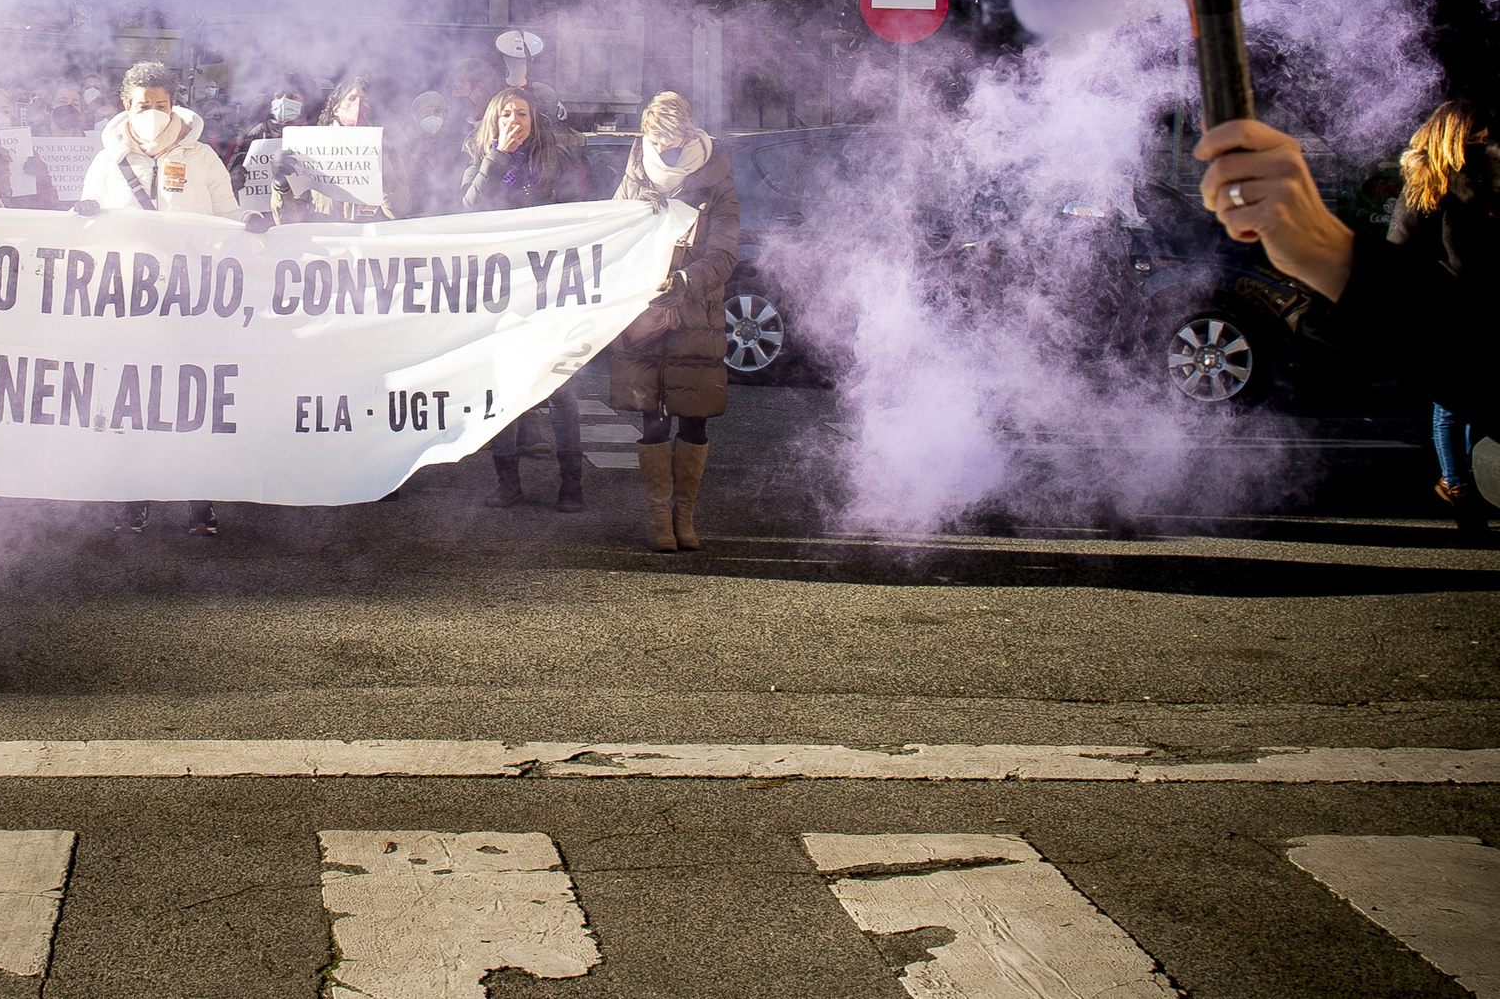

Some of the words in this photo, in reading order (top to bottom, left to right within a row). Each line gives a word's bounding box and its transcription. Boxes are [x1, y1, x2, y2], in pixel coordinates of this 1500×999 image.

[306, 146, 379, 155] BALDINTZA
[327, 161, 371, 171] ZAHAR
[37, 247, 254, 328] TRABAJO,
[272, 252, 511, 316] CONVENIO
[527, 244, 603, 310] YA!
[110, 364, 239, 433] ALDE
[295, 395, 353, 432] ELA
[389, 390, 450, 432] UGT
